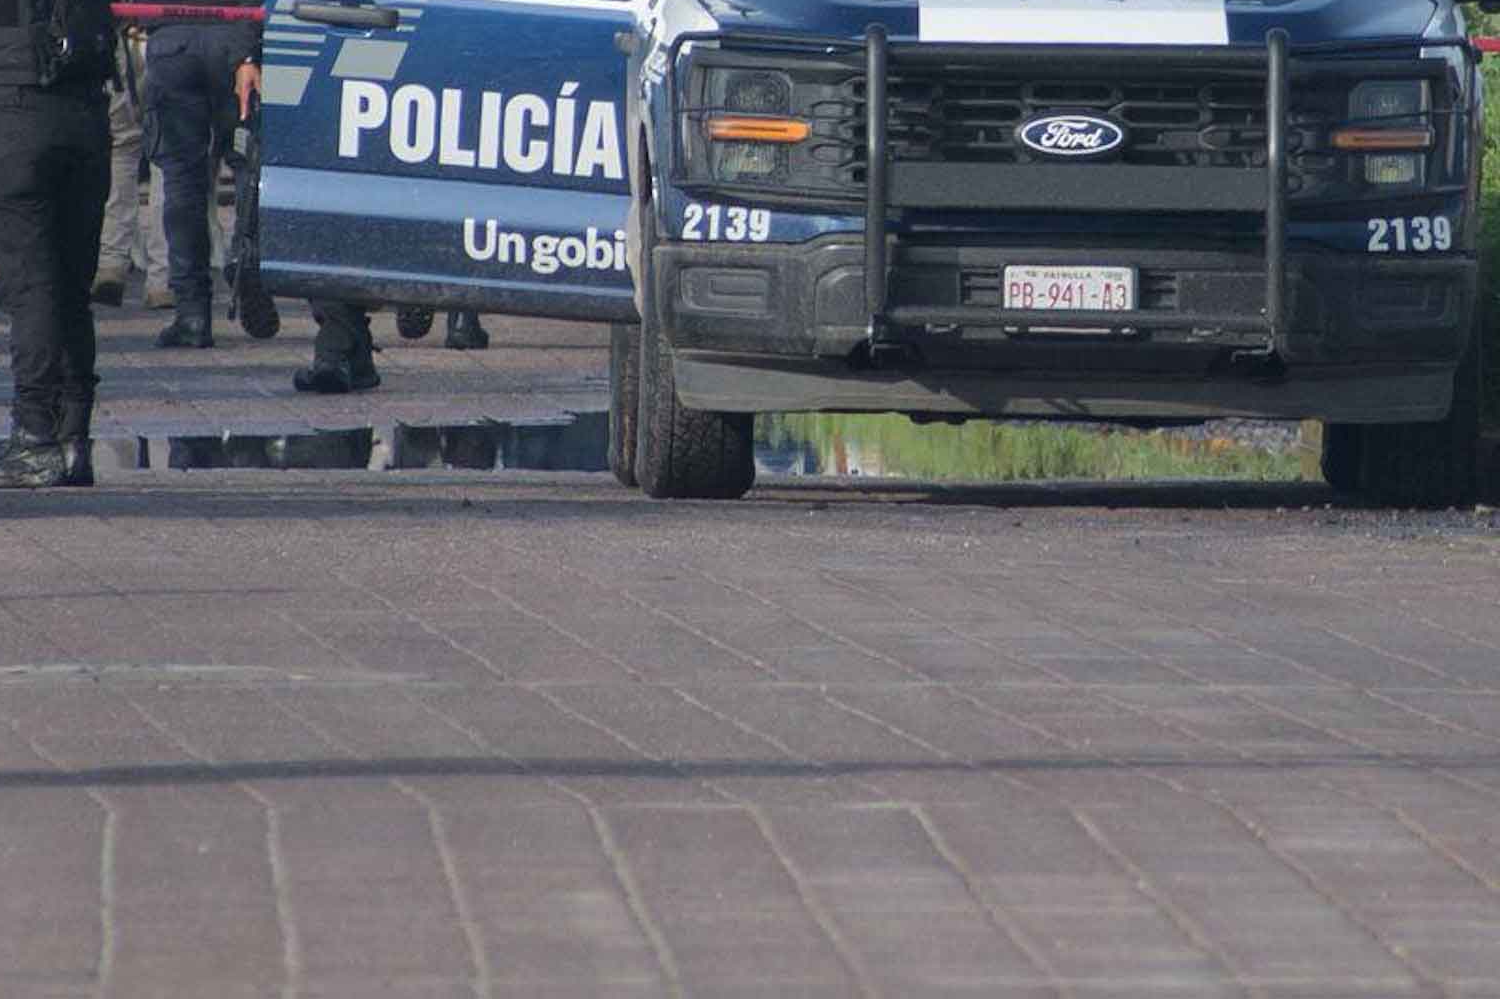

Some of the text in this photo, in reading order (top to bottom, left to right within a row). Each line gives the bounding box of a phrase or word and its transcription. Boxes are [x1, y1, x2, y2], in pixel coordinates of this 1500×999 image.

[338, 80, 623, 180] POLICÍA
[1040, 120, 1102, 149] Ford
[681, 203, 771, 242] 2139
[1367, 215, 1452, 252] 2139
[463, 217, 630, 276] Un gobi
[1009, 281, 1127, 309] PB-941-A3
